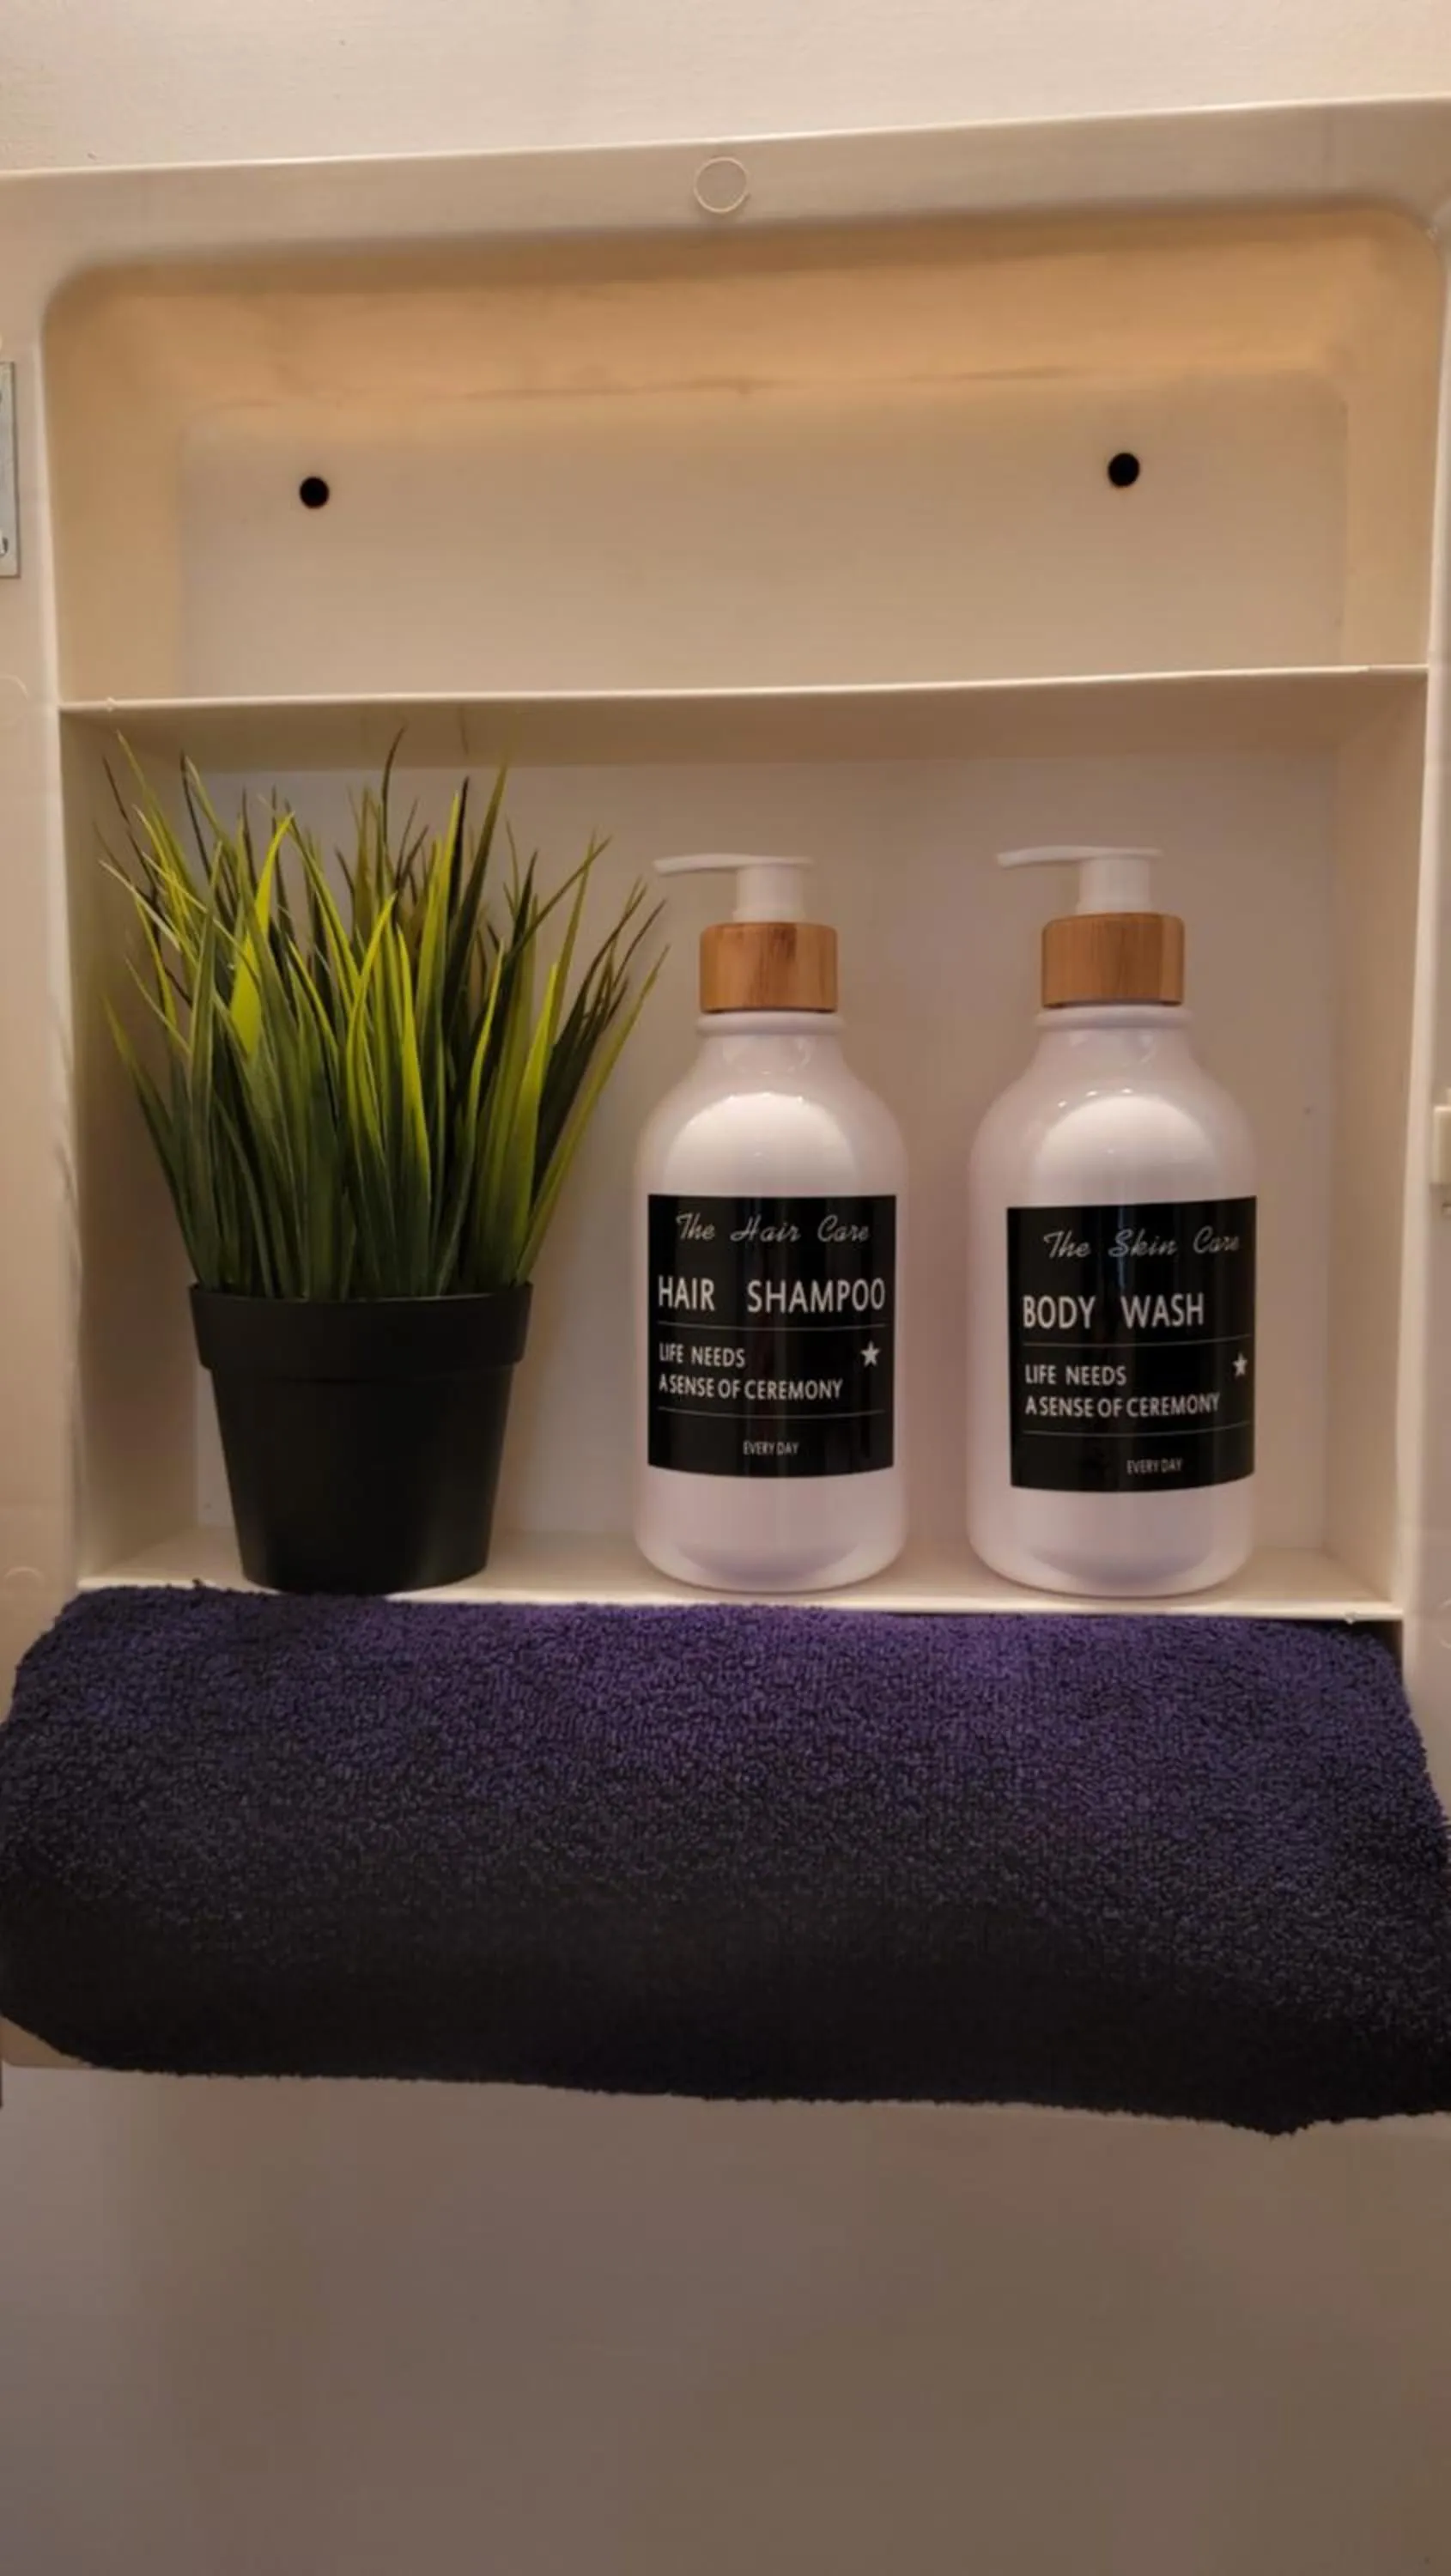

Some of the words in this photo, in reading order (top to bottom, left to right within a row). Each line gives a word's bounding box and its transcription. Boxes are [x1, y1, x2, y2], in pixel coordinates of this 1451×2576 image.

[676, 1212, 715, 1241] The
[730, 1215, 802, 1242] Hair
[817, 1214, 871, 1242] Care
[1043, 1230, 1091, 1260] The
[1108, 1228, 1177, 1258] Skin
[1193, 1225, 1240, 1254] Care
[658, 1274, 715, 1311] HAIR
[747, 1278, 886, 1314] SHAMPOO
[1023, 1295, 1096, 1329] BODY
[1120, 1293, 1205, 1329] WASH
[659, 1342, 684, 1364] LIFE
[690, 1346, 746, 1368] NEEDS
[1024, 1364, 1056, 1385] LIFE
[1065, 1364, 1127, 1386] NEEDS
[718, 1378, 741, 1400] OF
[744, 1378, 843, 1400] CEREMONY
[1097, 1397, 1121, 1418] OF
[1126, 1393, 1220, 1418] CEREMONY
[743, 1440, 775, 1455] EVERY
[776, 1442, 799, 1455] DAY
[1126, 1459, 1159, 1474] EVERY
[1161, 1458, 1184, 1473] DAY
